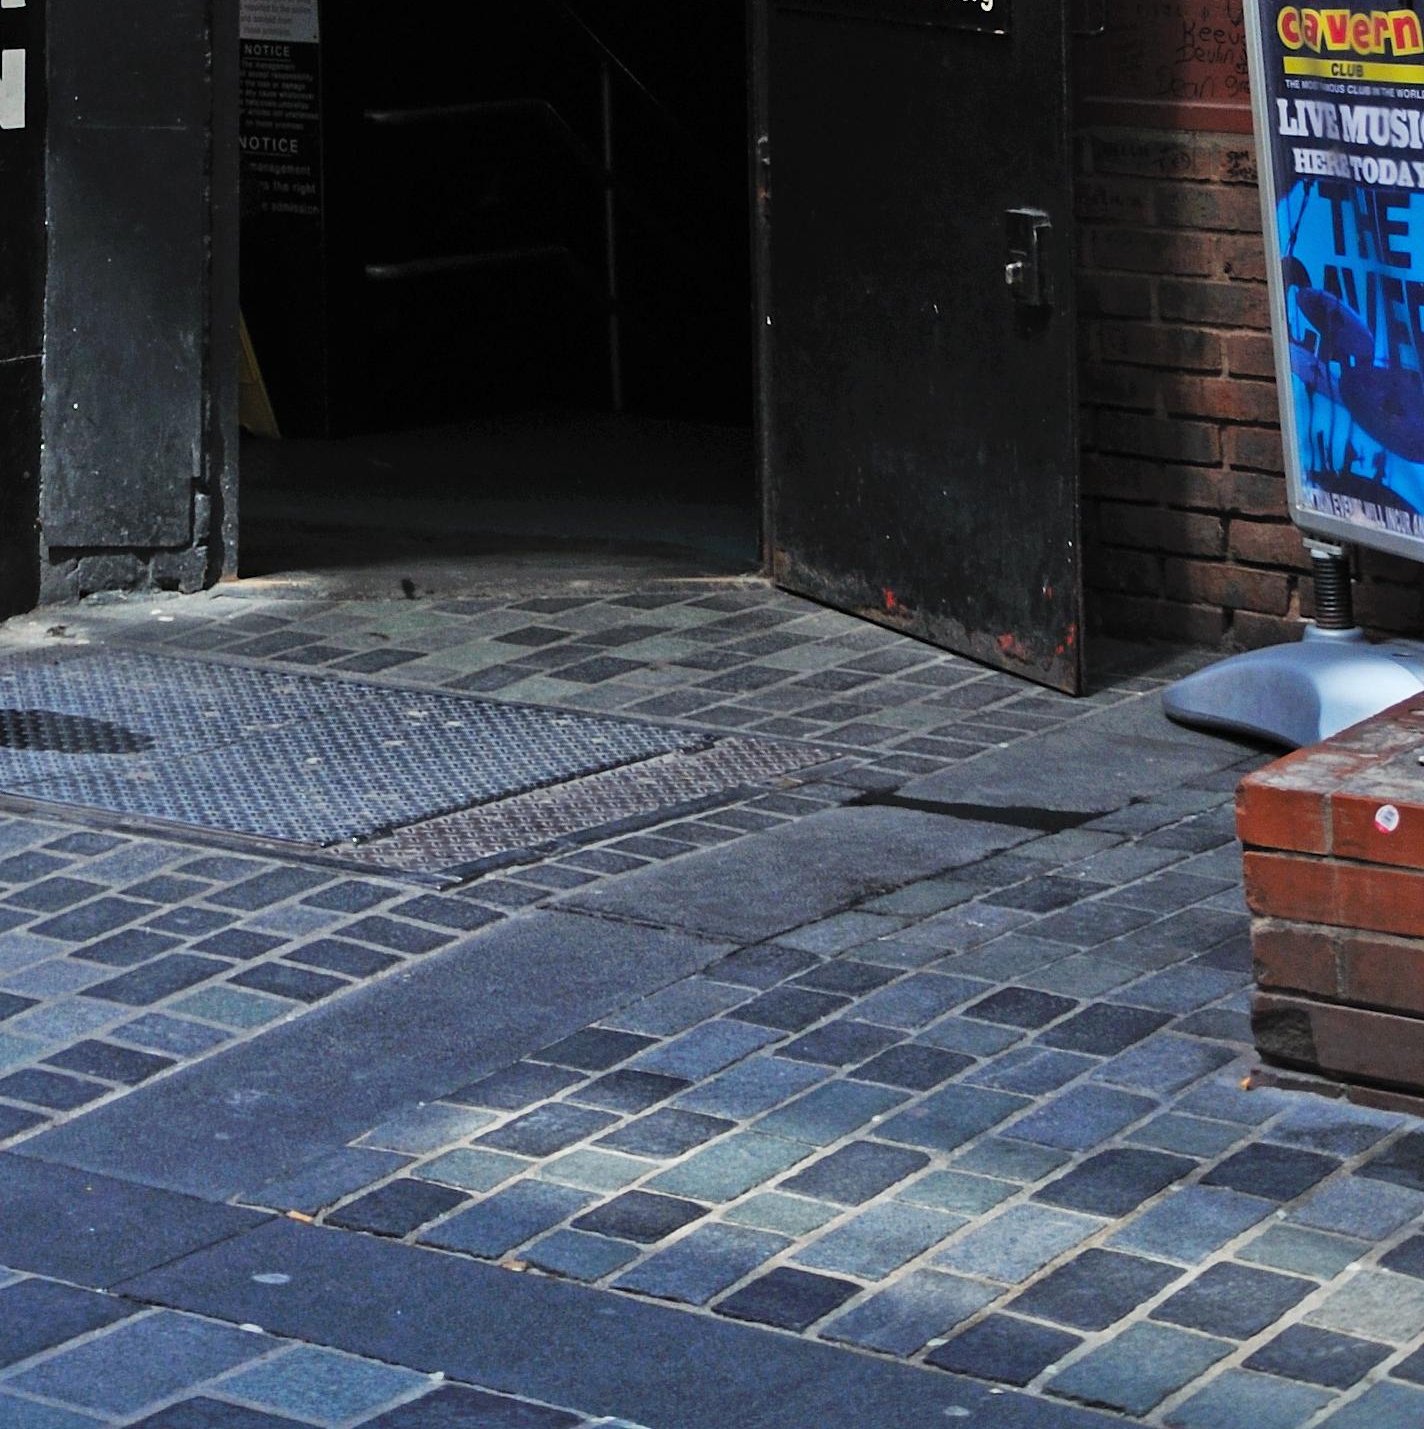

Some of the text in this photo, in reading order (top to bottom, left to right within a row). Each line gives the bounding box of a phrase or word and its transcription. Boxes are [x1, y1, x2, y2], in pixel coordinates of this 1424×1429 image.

[1277, 5, 1424, 57] cavern
[244, 43, 291, 58] NOTICE
[1330, 62, 1364, 78] CLUB
[1285, 78, 1301, 89] THE
[1276, 98, 1339, 141] LIVE
[238, 135, 299, 154] NOTICE
